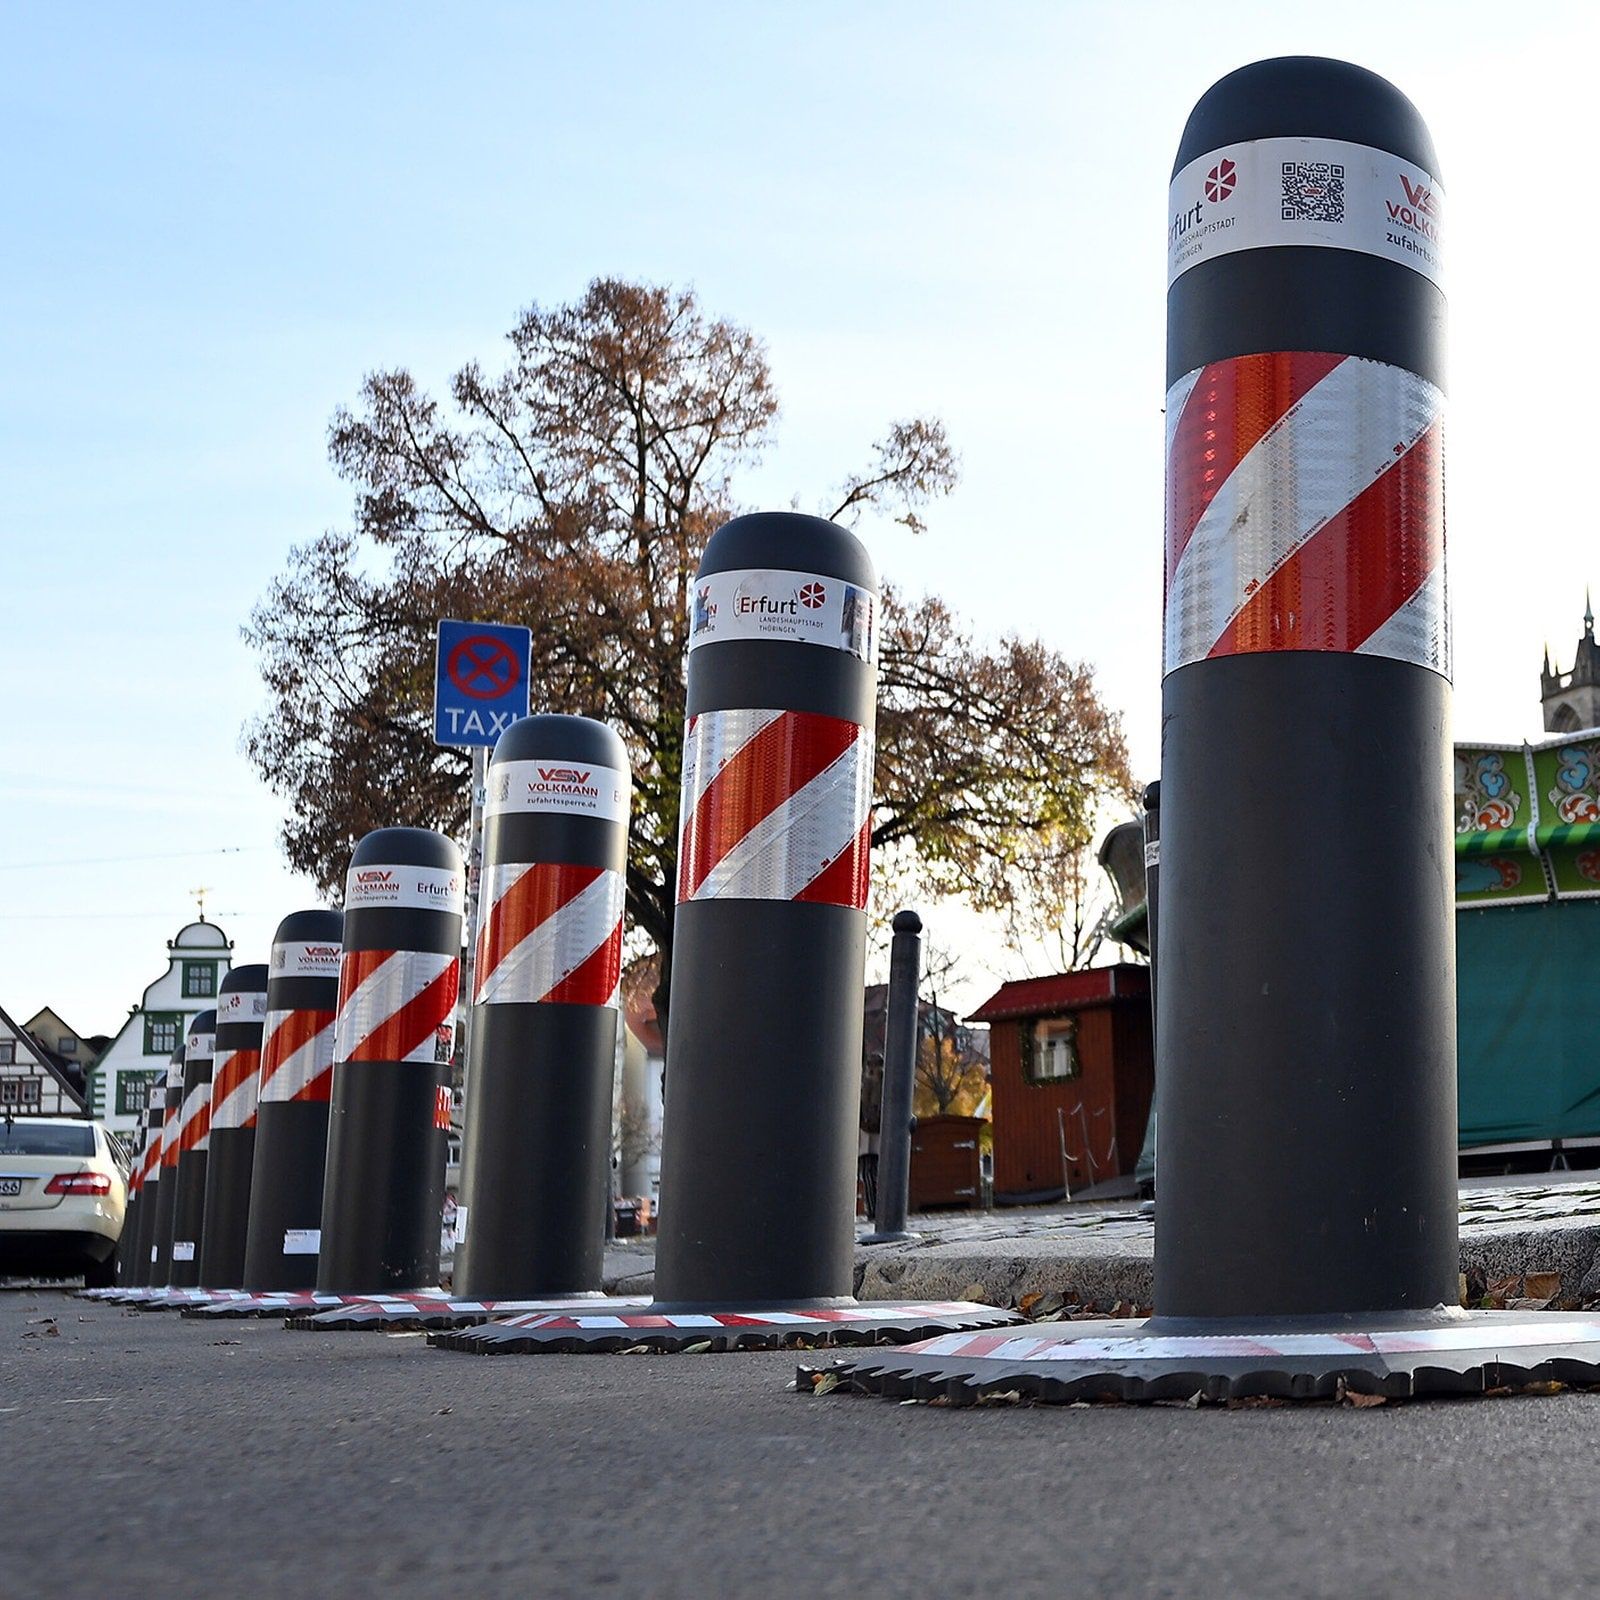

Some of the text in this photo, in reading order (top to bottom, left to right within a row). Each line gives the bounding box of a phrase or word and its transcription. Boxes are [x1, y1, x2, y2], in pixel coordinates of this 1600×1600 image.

[740, 595, 798, 615] Erfurt
[759, 616, 824, 628] LANDESHAUPTSTADT
[537, 767, 591, 784] VSV
[528, 783, 599, 797] VOLKMANN
[527, 797, 597, 809] zufahrtssperre.de
[357, 871, 392, 882] VSV
[417, 882, 448, 896] Erfurt
[298, 956, 341, 964] VOLKMAN
